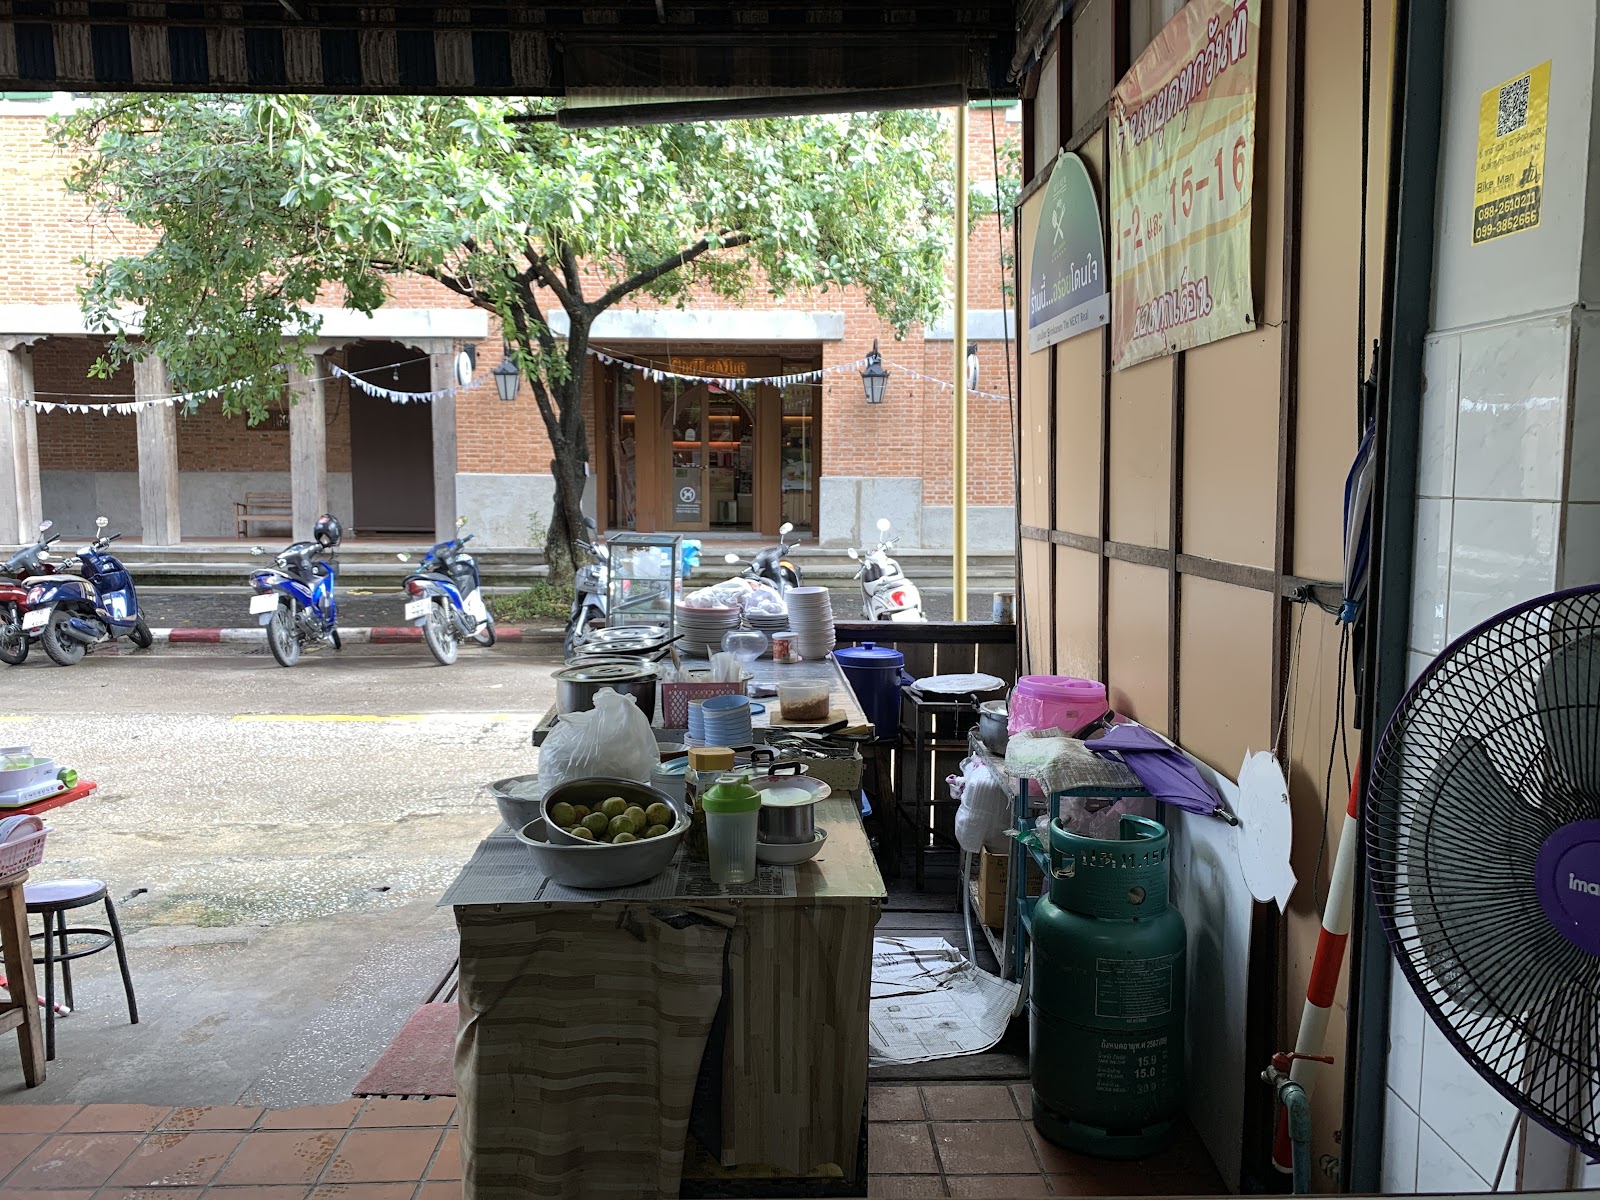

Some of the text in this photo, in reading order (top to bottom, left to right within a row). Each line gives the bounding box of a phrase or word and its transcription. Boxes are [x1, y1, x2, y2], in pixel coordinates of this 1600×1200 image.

[1114, 0, 1249, 159] ร้านหยุดทุกวันที
[1116, 135, 1247, 261] 1-2 และ 15-16
[1476, 173, 1515, 194] Bike Man
[1478, 191, 1536, 221] 088-2610211
[1475, 209, 1537, 239] 099-3862666
[1132, 265, 1213, 351] ของทุกเดือน
[1134, 1066, 1156, 1079] 15.0
[1137, 1054, 1158, 1067] 15.9
